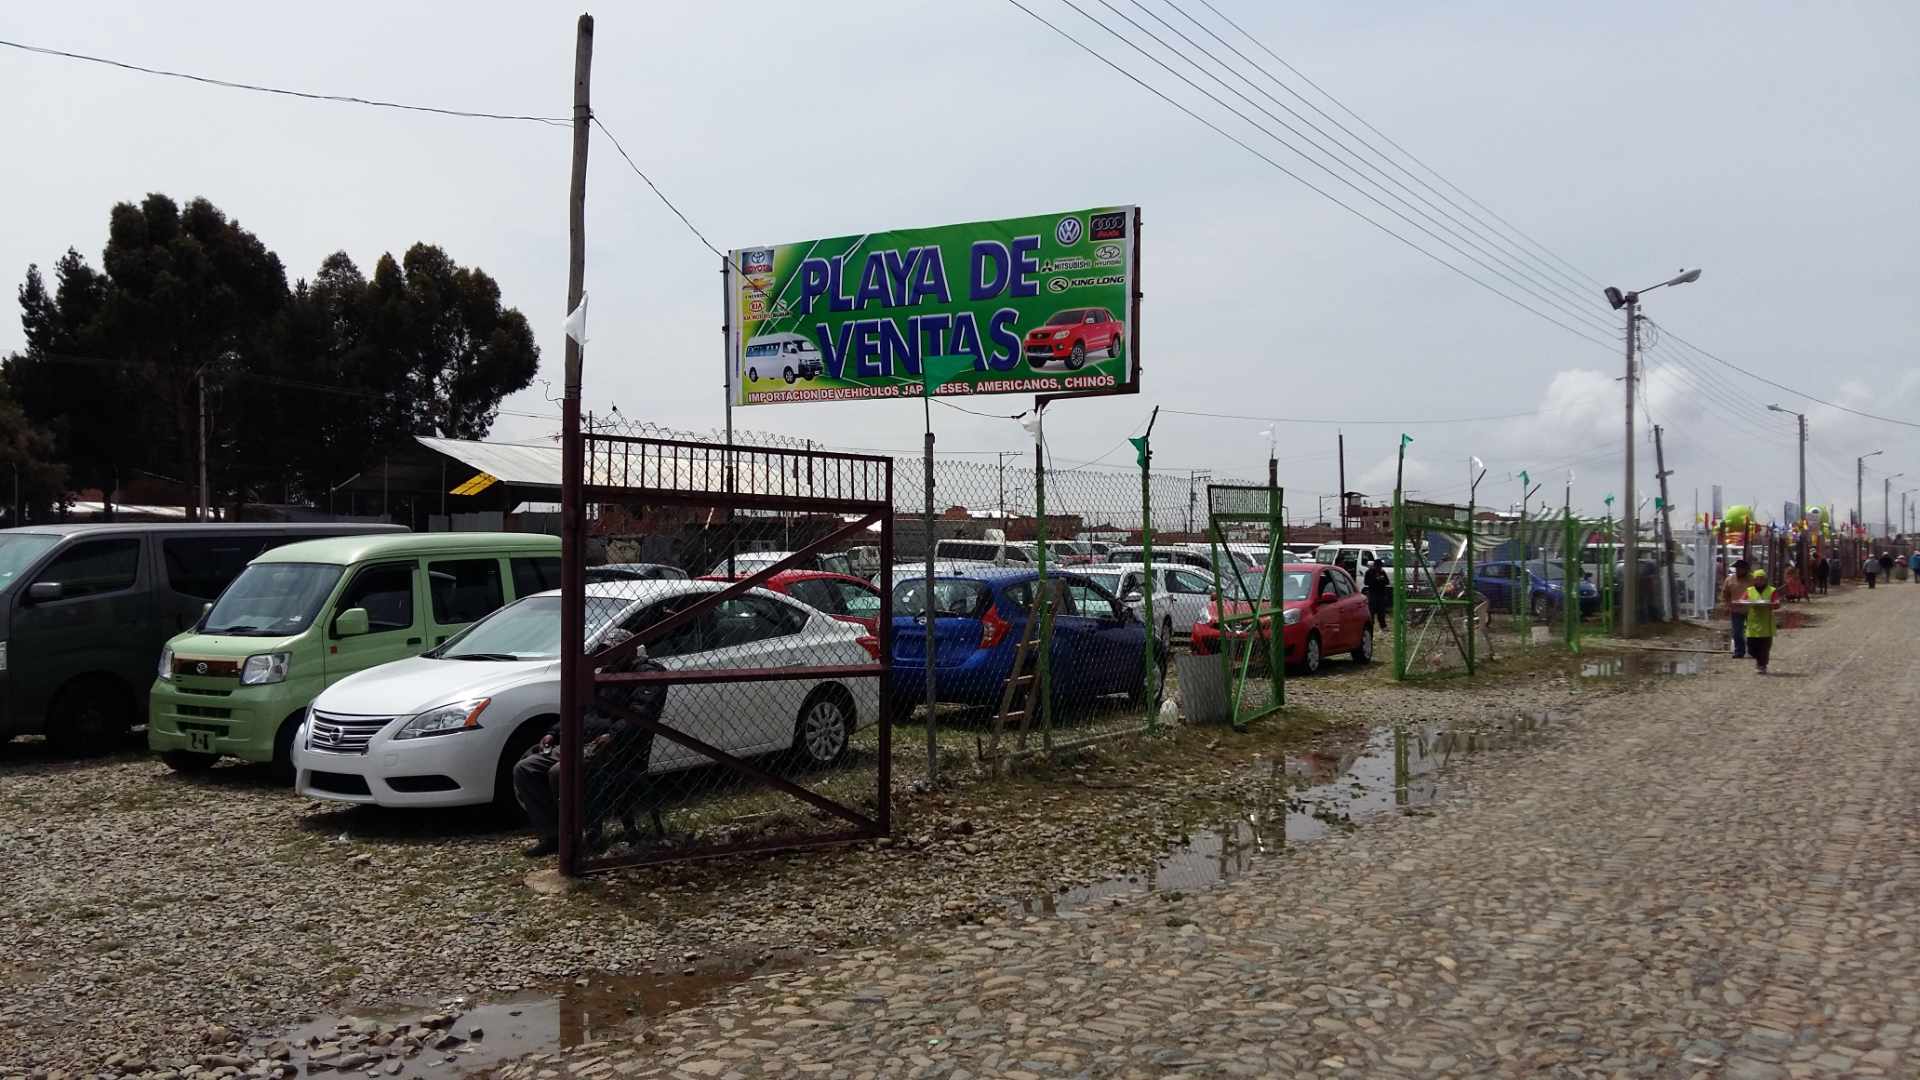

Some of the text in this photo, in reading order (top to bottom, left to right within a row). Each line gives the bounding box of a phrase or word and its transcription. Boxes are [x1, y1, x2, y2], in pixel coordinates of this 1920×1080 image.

[801, 234, 1041, 314] PLAYA DE
[1071, 275, 1125, 287] KING LONG
[816, 307, 1022, 379] VENTAS
[748, 390, 822, 404] IMPORTACION
[822, 388, 836, 400] DE
[836, 384, 899, 399] VEHICULOS
[977, 378, 1062, 393] AMERICANOS,
[1064, 375, 1116, 388] CHINOS
